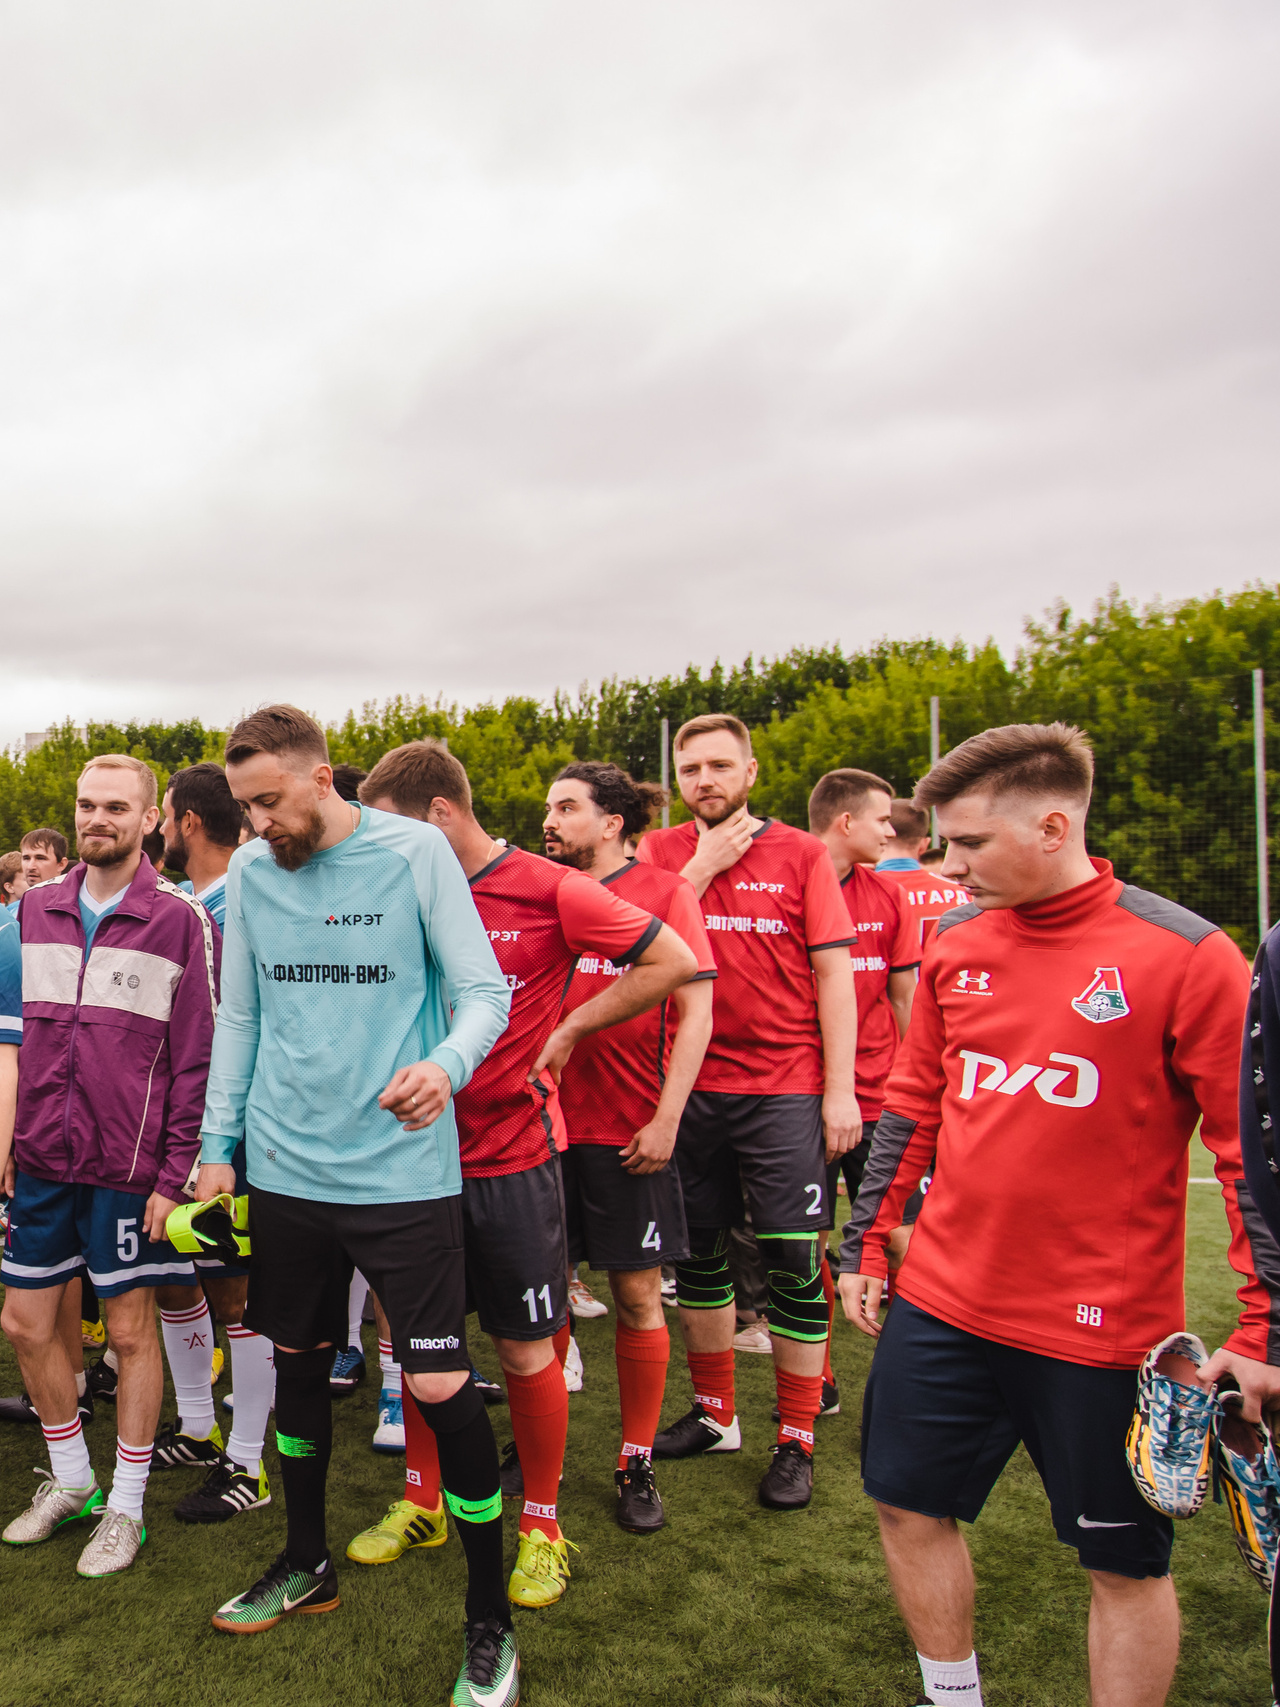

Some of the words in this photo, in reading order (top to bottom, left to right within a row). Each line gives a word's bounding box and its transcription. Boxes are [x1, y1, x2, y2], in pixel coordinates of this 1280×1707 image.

[750, 882, 785, 893] КРЭТ
[342, 914, 383, 926] КРЭТ
[803, 1184, 822, 1216] 2
[117, 1218, 139, 1262] 5
[641, 1221, 661, 1251] 4
[521, 1284, 553, 1323] 11
[1076, 1303, 1102, 1327] 98
[410, 1335, 460, 1350] macron
